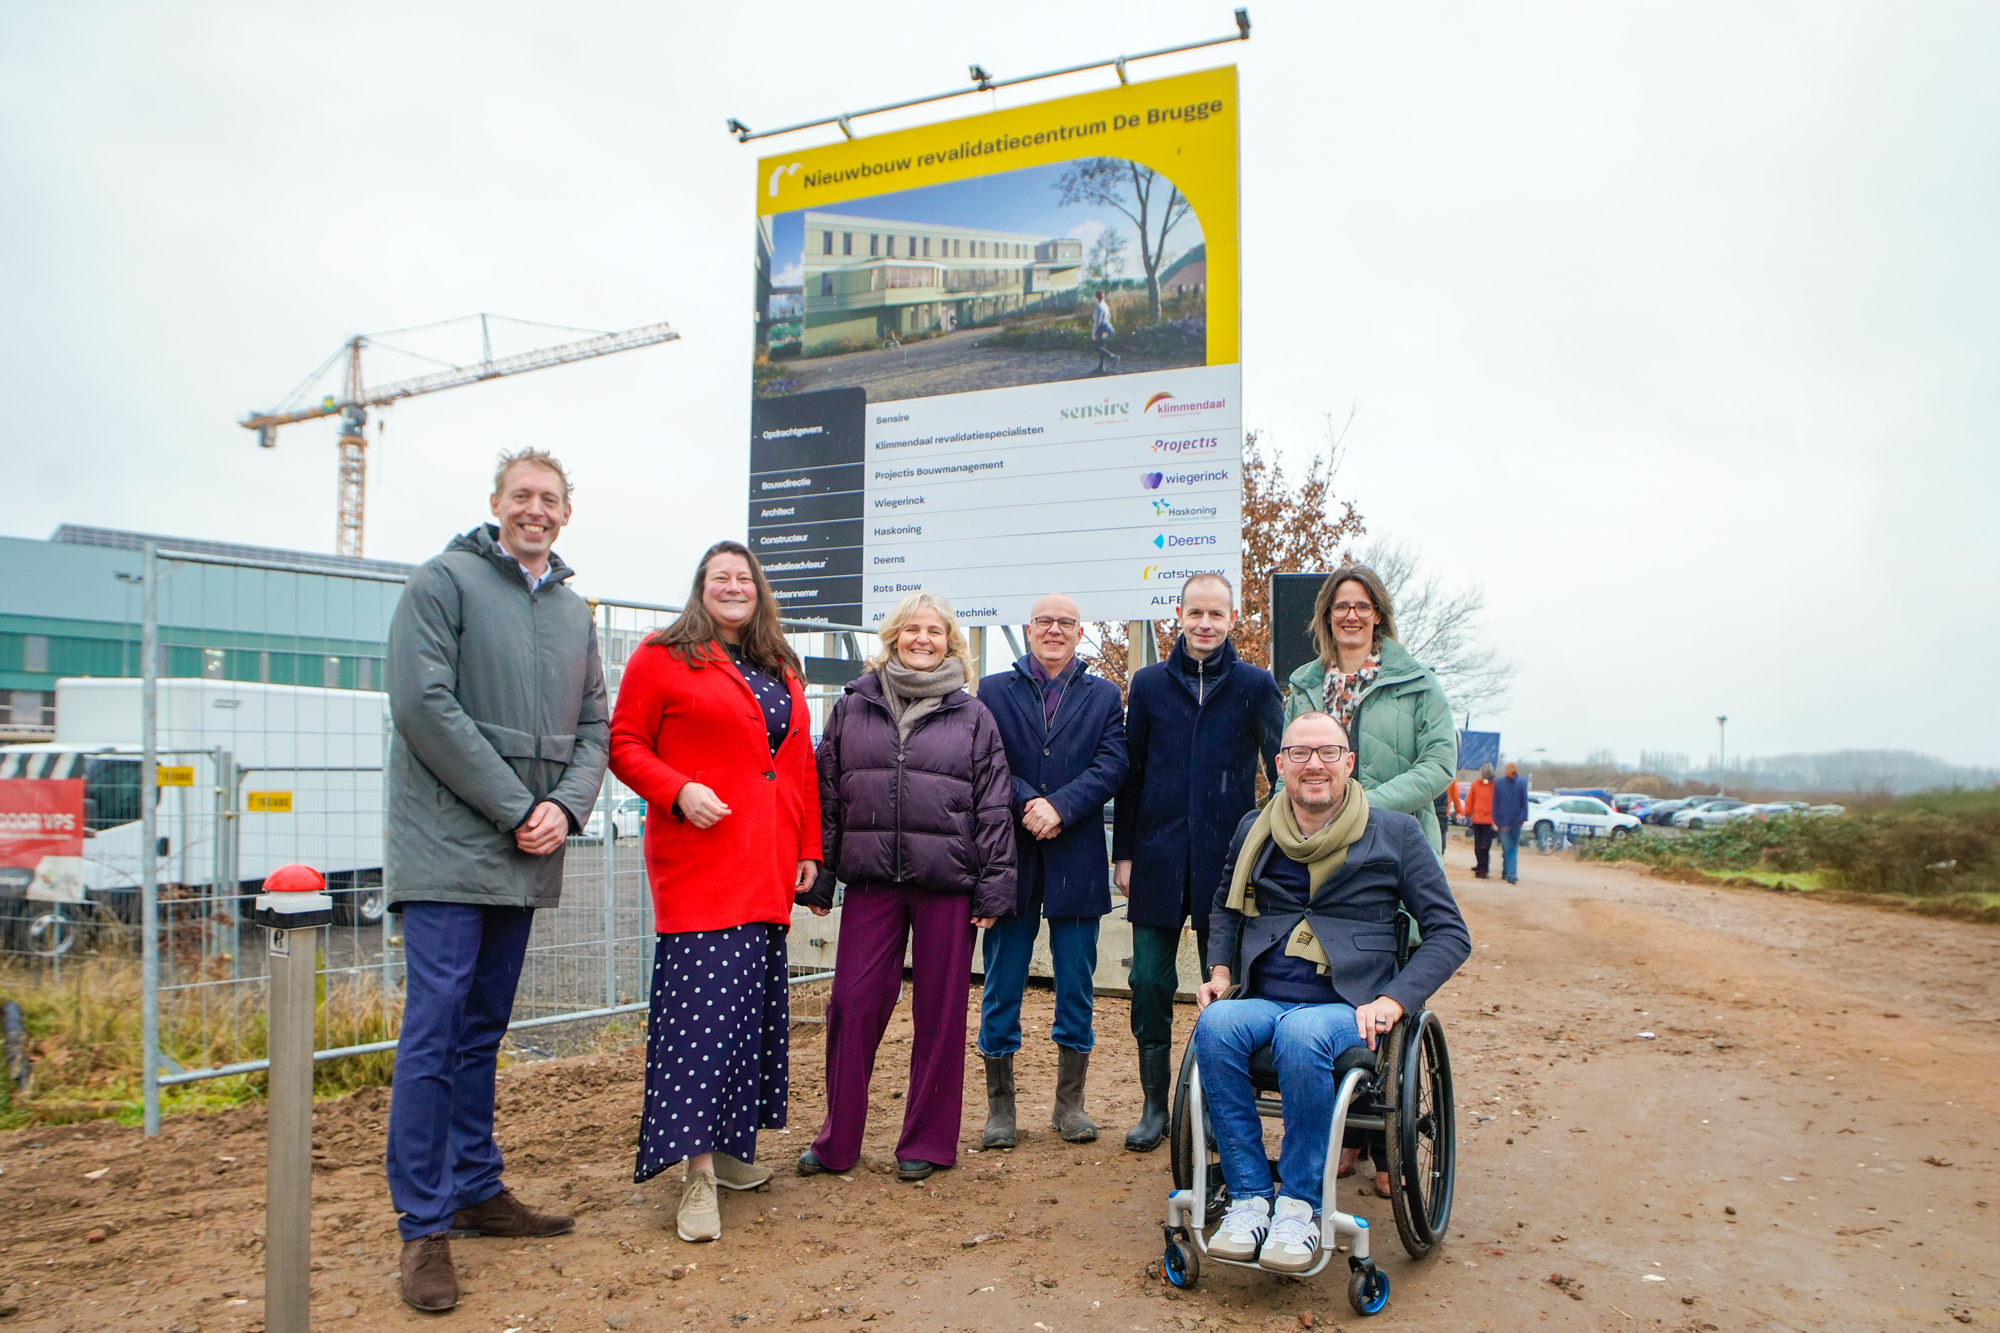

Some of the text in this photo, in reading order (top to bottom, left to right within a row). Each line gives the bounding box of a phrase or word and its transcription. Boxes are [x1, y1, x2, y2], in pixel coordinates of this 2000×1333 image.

[803, 99, 1223, 188] Nieuwbouw revalidatiecentrum De Brugge
[1060, 397, 1130, 421] sensire
[1157, 398, 1226, 414] klimmendaal
[876, 413, 910, 425] Sensire
[762, 425, 823, 440] Opdrachtgevers
[875, 426, 1044, 450] Klimmendaal revalidatiespecialisten
[1151, 437, 1218, 453] Projectis
[874, 460, 1004, 481] Projectis Bouwmanagement
[761, 477, 812, 490] Bouwdirectie
[1166, 470, 1229, 485] wiegerinck
[874, 496, 925, 508] Wiegerinck
[760, 507, 796, 518] Architect
[1168, 506, 1217, 517] Haskoning
[874, 524, 922, 536] Haskoning
[760, 534, 809, 545] Constructeur
[1168, 535, 1217, 547] Deerns
[760, 560, 827, 572] Installatieadviseur
[873, 555, 906, 565] Deerns
[873, 583, 922, 593] Rots Bouw
[772, 590, 819, 599] fdaannemer
[1150, 595, 1181, 605] ALFE
[955, 607, 998, 618] techniek
[43, 813, 75, 831] VPS
